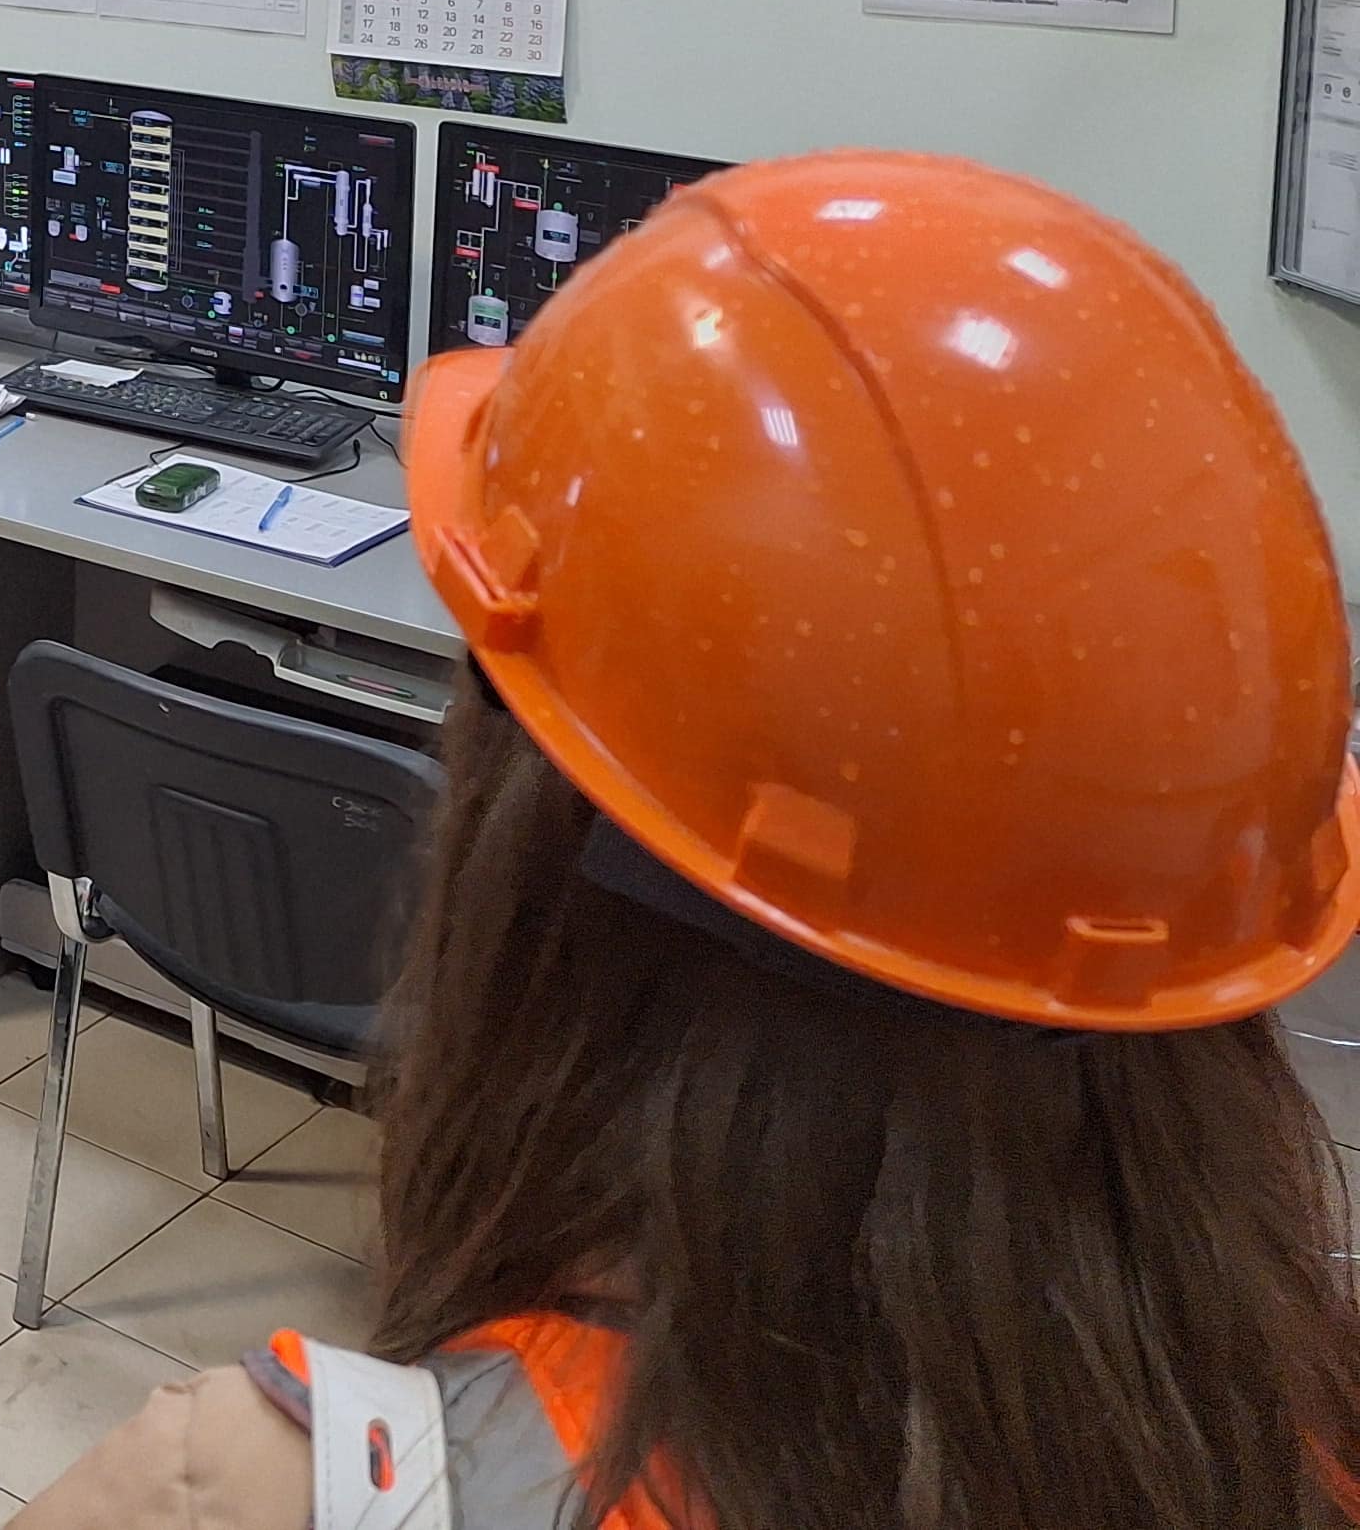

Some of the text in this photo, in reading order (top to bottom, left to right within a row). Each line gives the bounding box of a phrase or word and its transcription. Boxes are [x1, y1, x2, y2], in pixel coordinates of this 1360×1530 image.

[363, 4, 544, 31] 10 11 12 13 14 15 16
[504, 1, 513, 13] 8
[533, 4, 542, 16] 9
[362, 18, 543, 46] 17 18 19 20 21 22 23
[360, 32, 542, 61] 24 25 26 27 28 29 30
